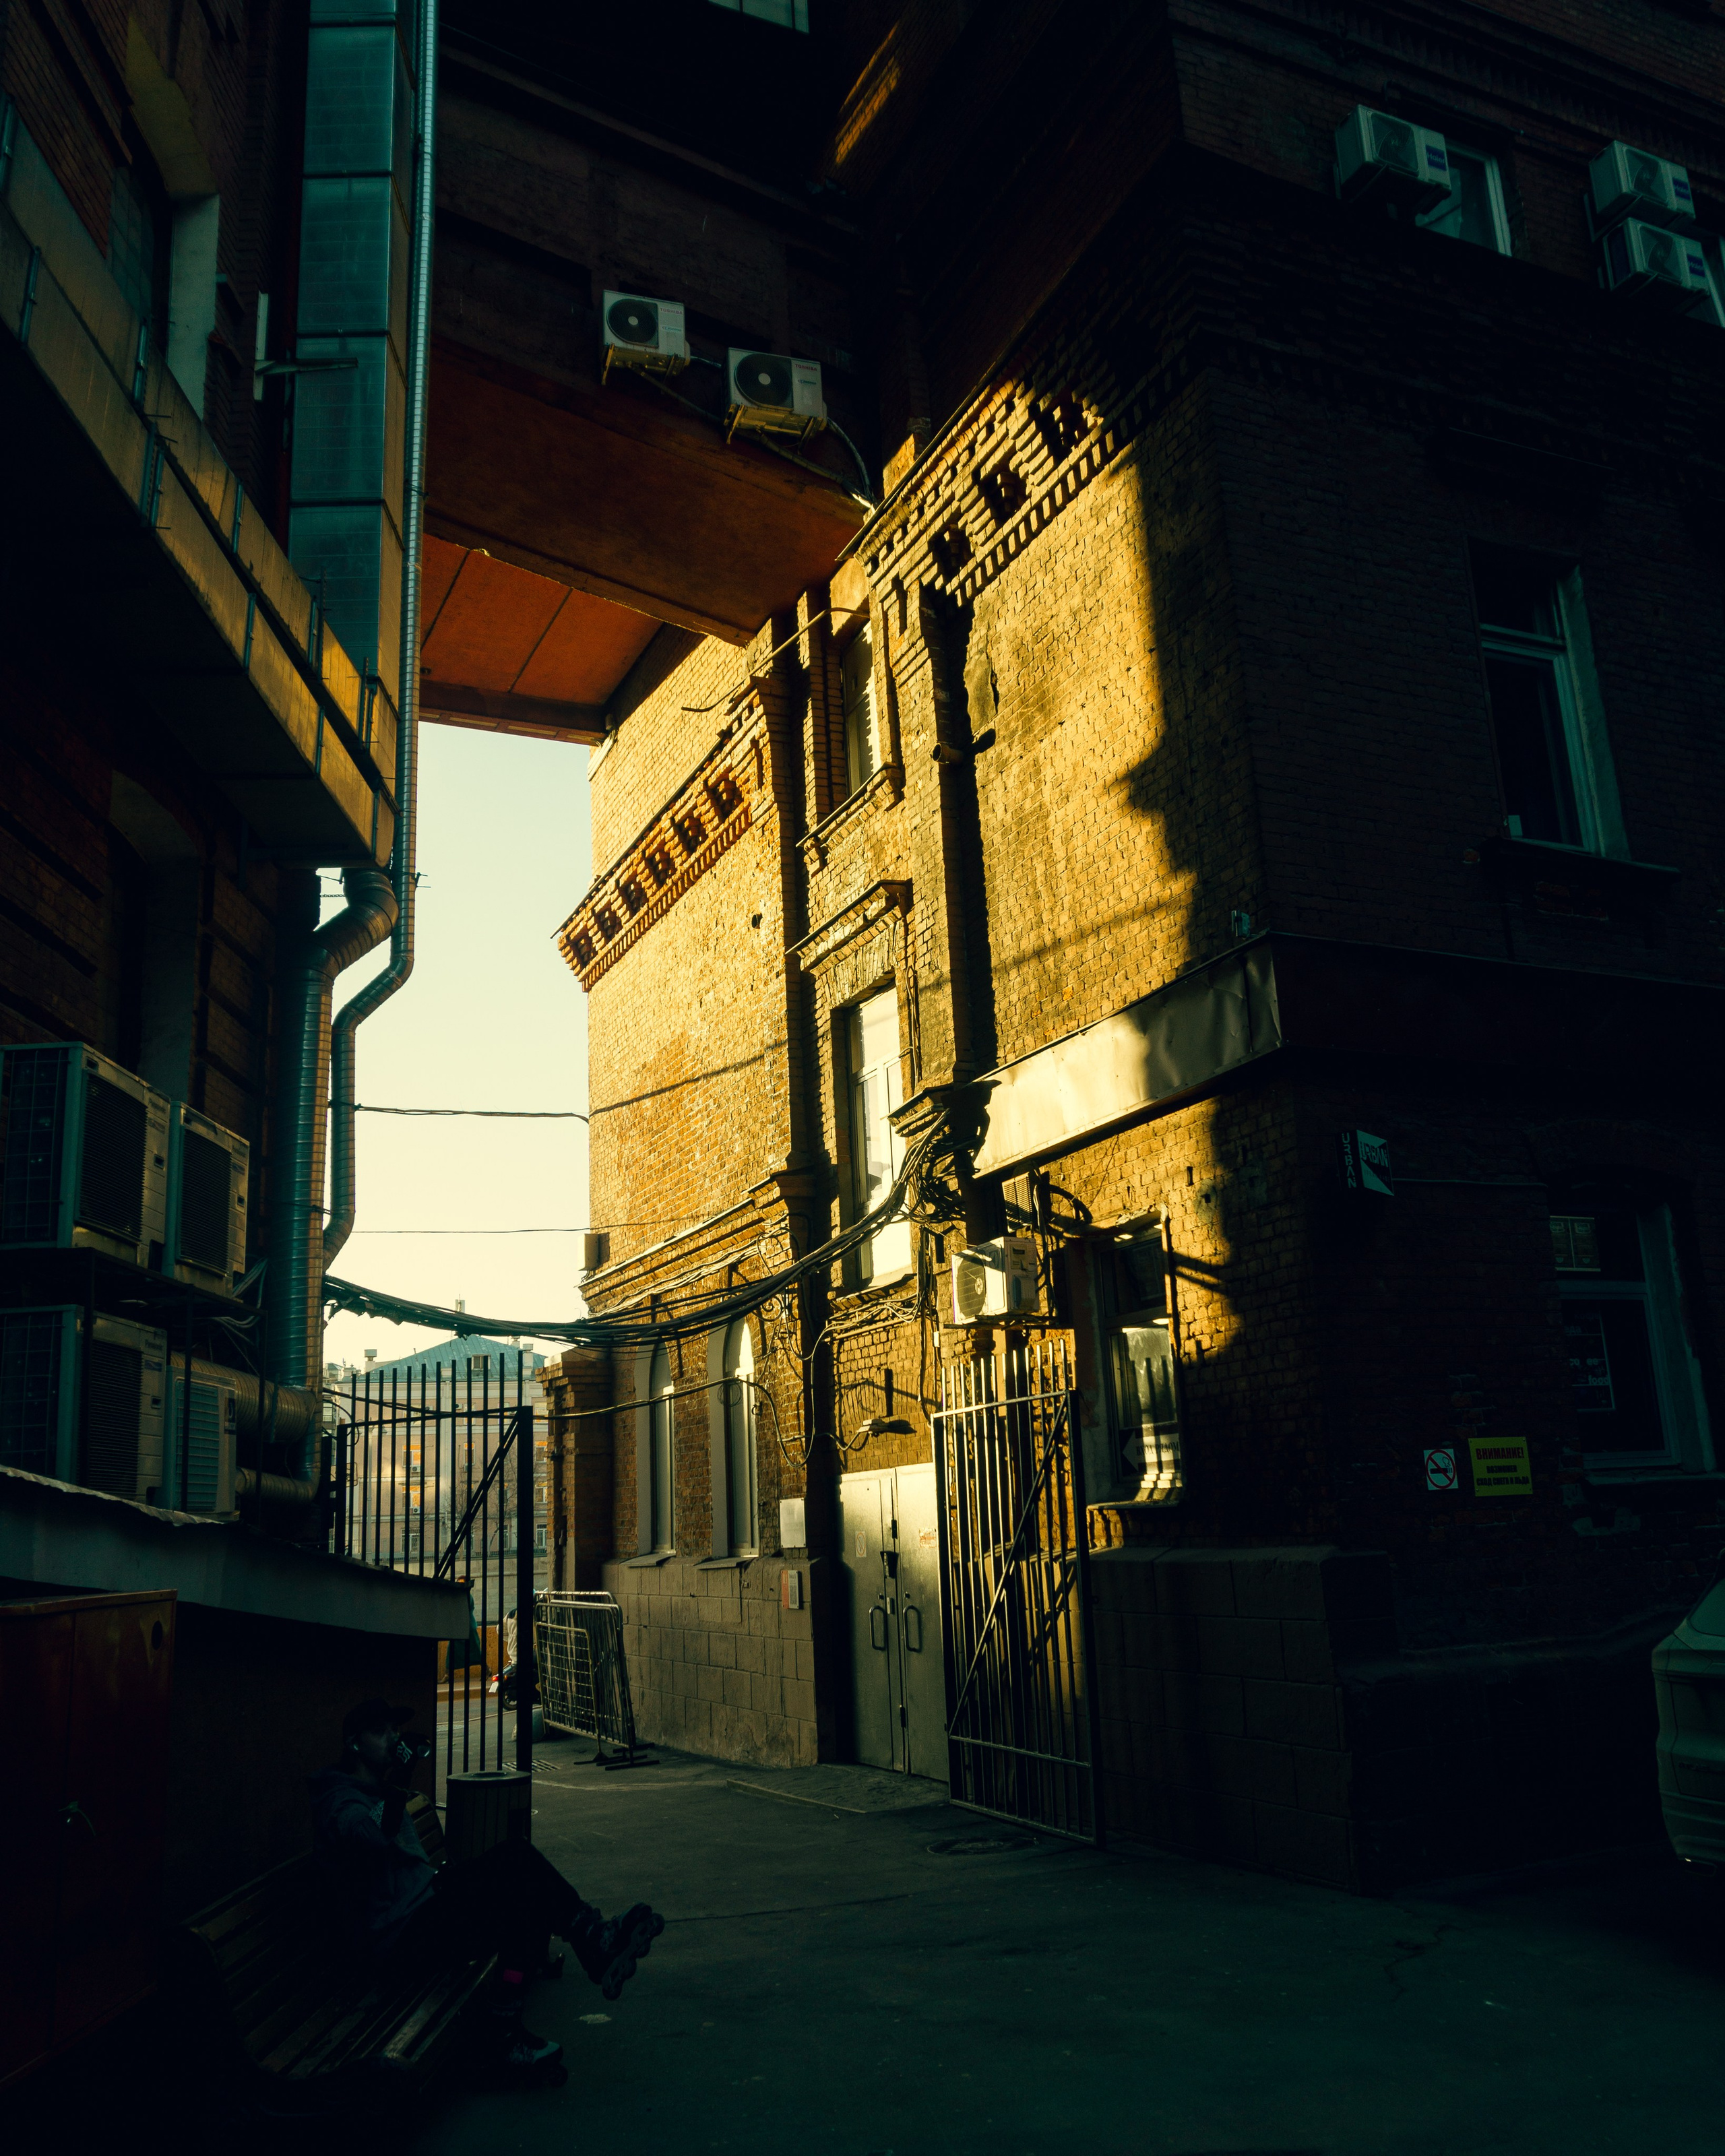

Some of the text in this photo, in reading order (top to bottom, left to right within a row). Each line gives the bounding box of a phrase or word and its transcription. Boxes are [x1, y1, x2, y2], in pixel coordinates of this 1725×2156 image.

[1341, 1132, 1357, 1188] URBAN
[1359, 1141, 1389, 1168] URBAN
[1475, 1447, 1525, 1460] ВНИМАНИЕ!
[1486, 1465, 1518, 1474] ВОЗМОЖЕН
[1476, 1477, 1493, 1486] СХОД
[1493, 1476, 1509, 1486] СНЕГА
[1514, 1476, 1530, 1486] ЛЬДА
